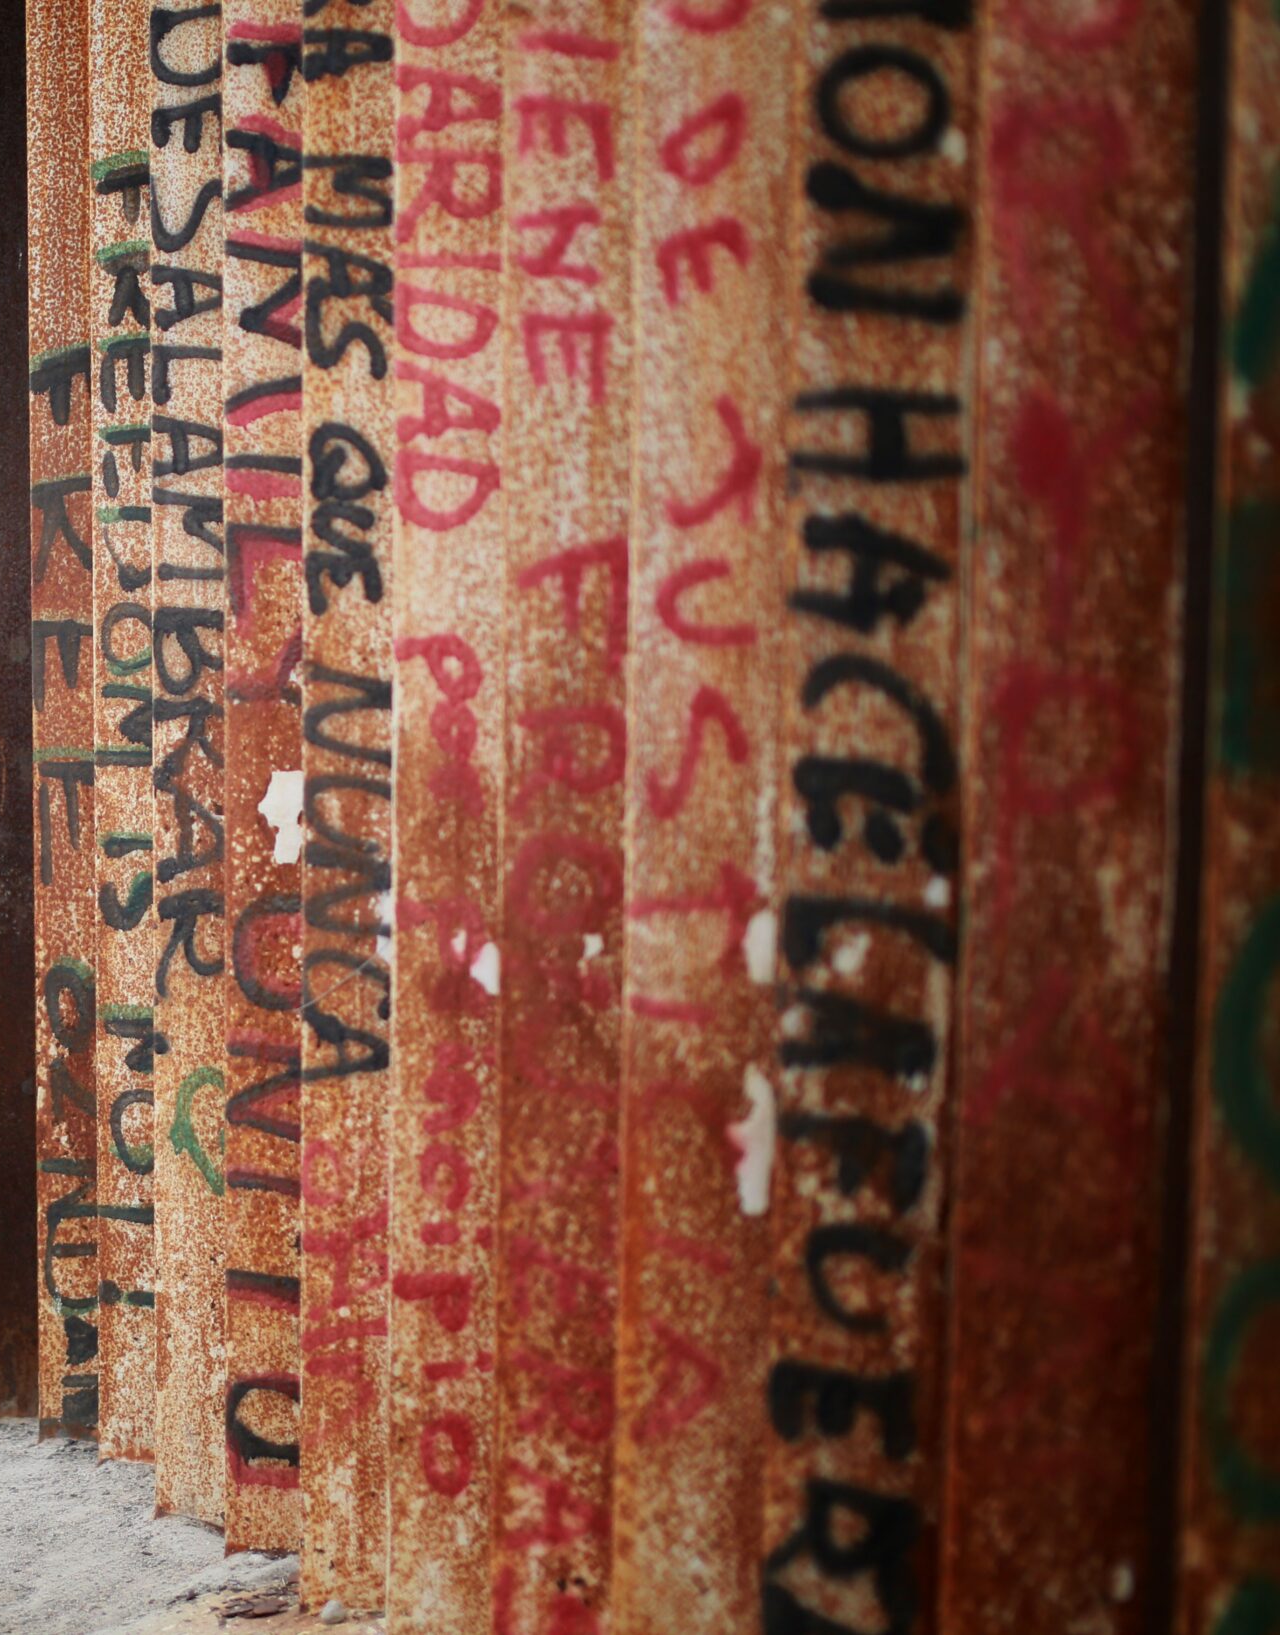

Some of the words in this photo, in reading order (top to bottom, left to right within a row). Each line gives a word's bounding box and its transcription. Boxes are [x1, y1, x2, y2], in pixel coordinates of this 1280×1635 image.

[30, 345, 93, 888] FREE
[306, 422, 387, 616] QUE
[300, 660, 394, 1082] NUNCA
[625, 395, 765, 1448] JUSTICIA
